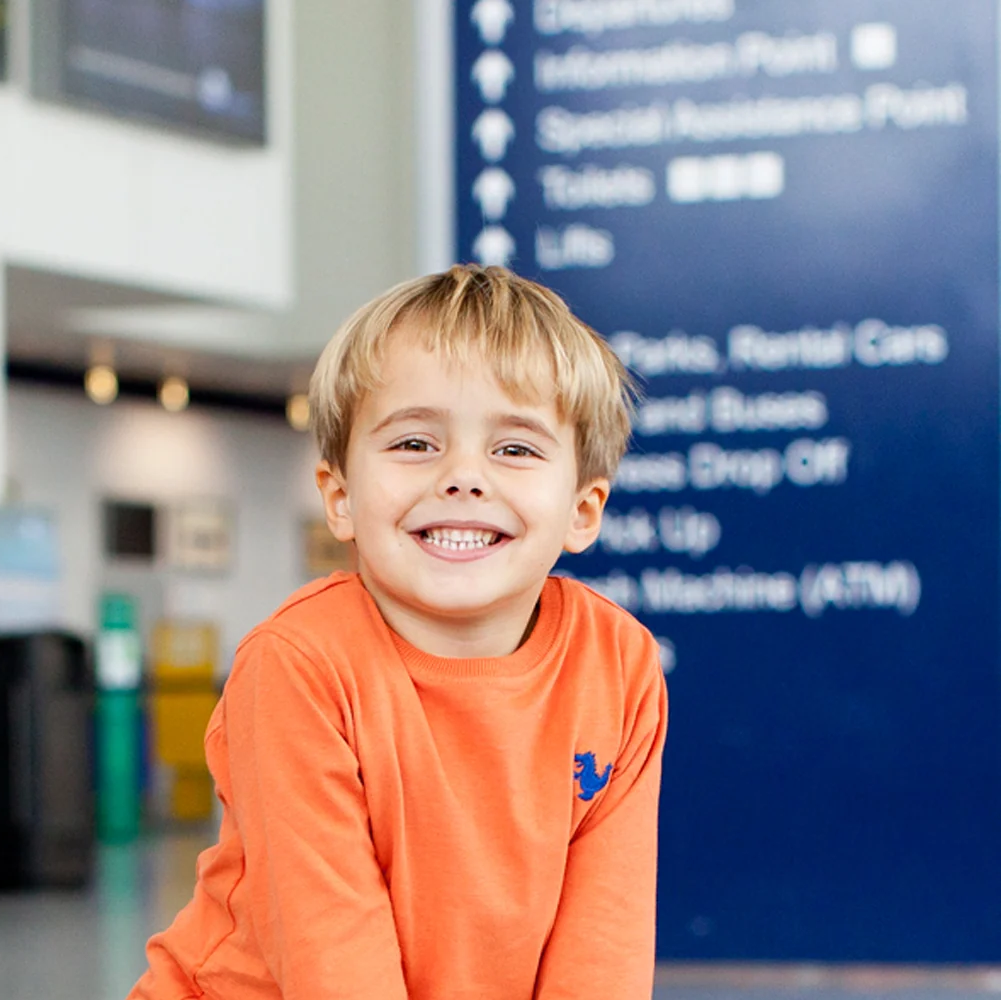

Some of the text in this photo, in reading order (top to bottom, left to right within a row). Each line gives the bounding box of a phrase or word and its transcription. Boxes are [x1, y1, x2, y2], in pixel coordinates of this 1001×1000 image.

[534, 32, 837, 91] Information Point
[536, 82, 967, 152] Special Assistance Point
[540, 164, 655, 208] Toilets
[536, 225, 614, 267] Lifts
[728, 324, 851, 370] Rental
[854, 319, 948, 365] Cars
[710, 387, 828, 431] Buses
[688, 443, 783, 494] Drop
[784, 438, 850, 486] Off
[659, 506, 721, 558] Up
[641, 567, 797, 613] Machine
[801, 562, 921, 616] (ATM)
